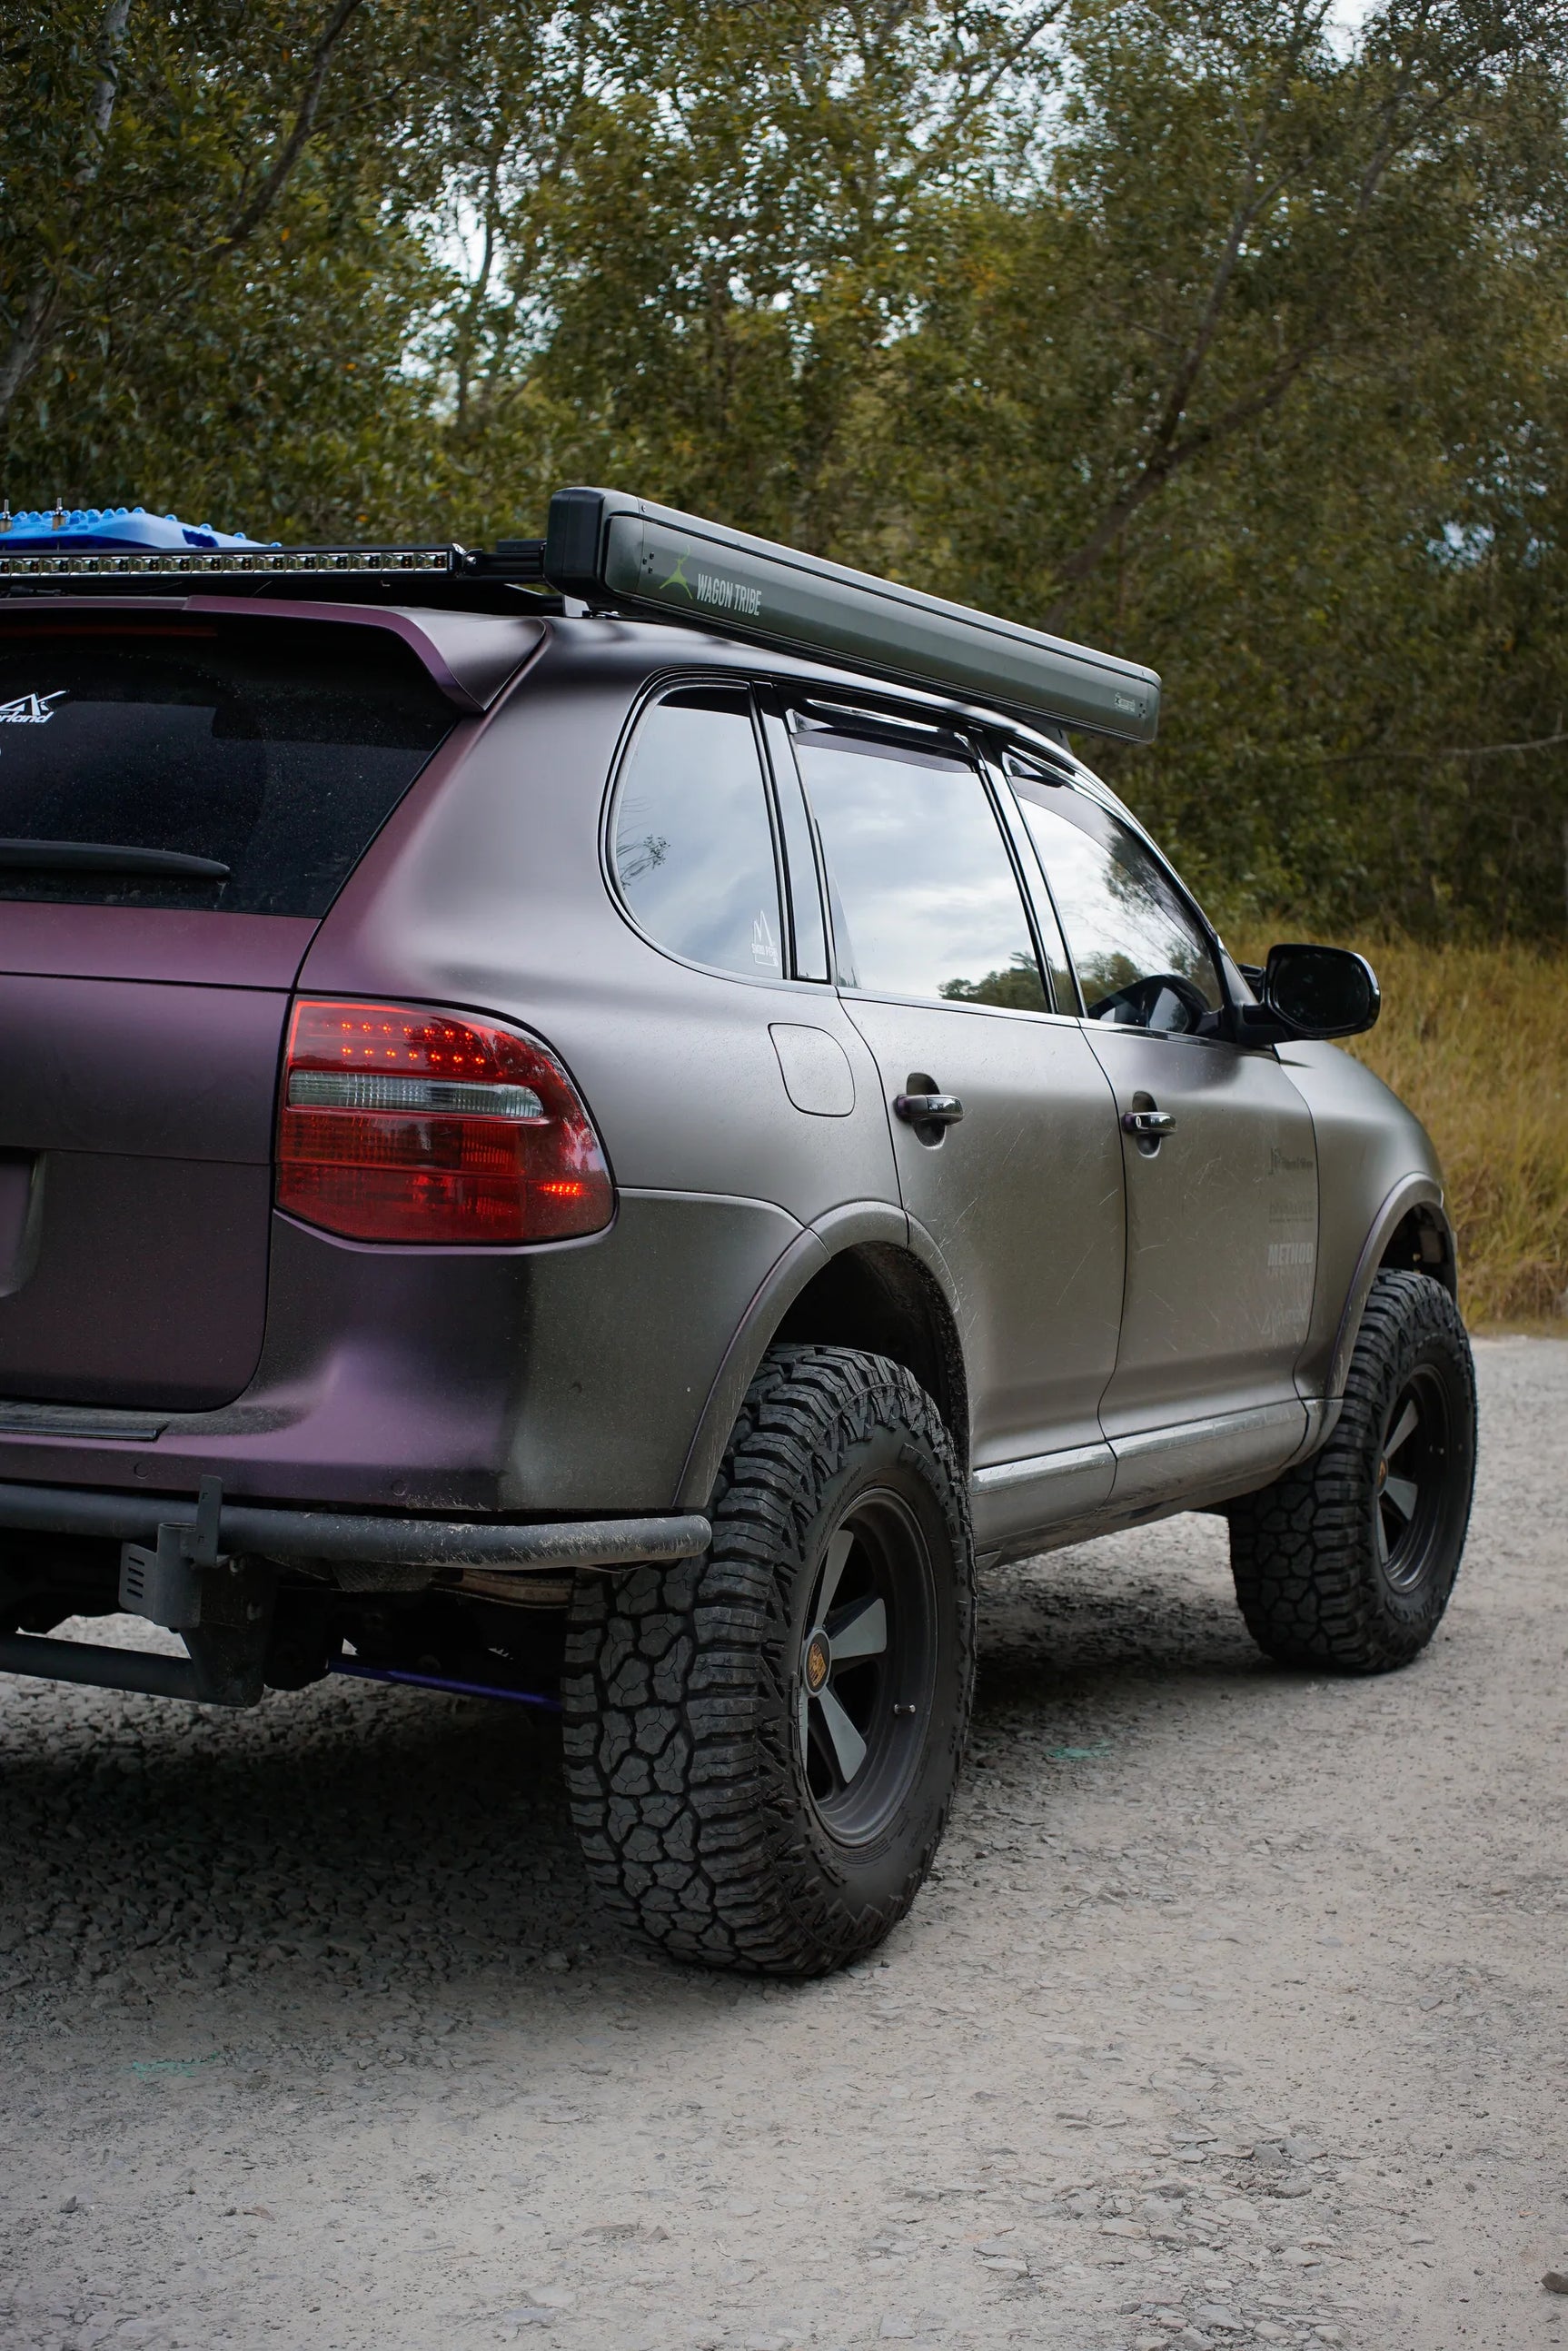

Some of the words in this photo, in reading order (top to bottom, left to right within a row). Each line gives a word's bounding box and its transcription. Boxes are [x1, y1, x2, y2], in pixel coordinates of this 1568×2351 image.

[697, 573, 733, 609] WAGON
[734, 584, 761, 616] TRIBE
[0, 711, 55, 723] rland
[1267, 1243, 1314, 1265] METHOD
